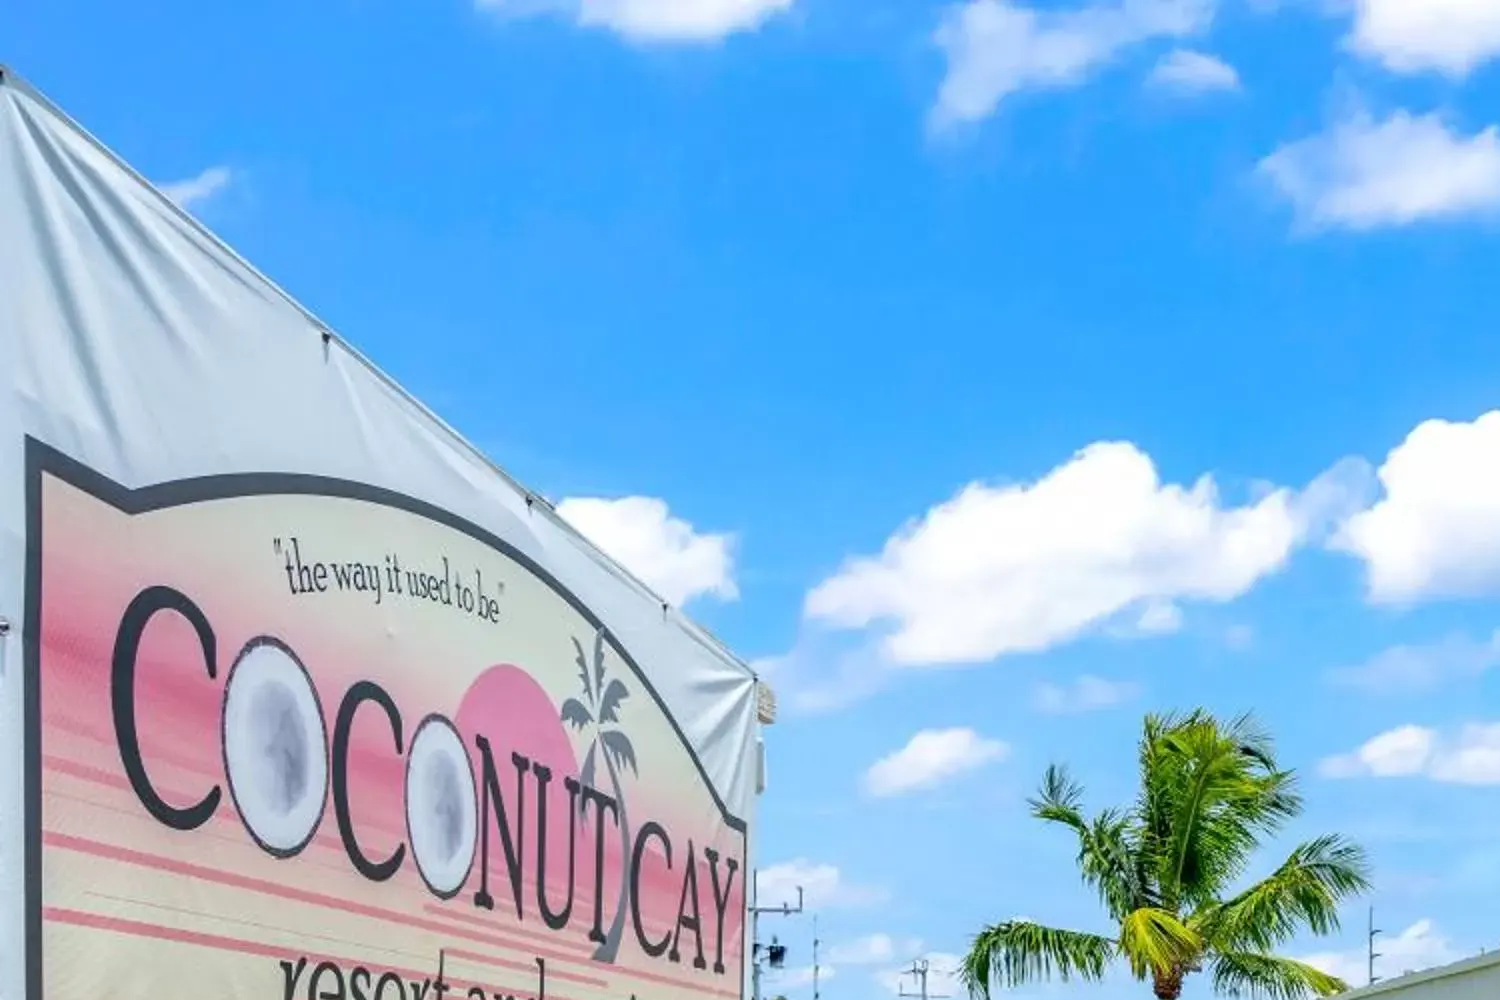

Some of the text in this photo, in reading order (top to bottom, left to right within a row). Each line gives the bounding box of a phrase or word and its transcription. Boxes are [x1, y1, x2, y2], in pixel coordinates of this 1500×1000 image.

[273, 537, 327, 595] "the
[331, 561, 381, 605] way
[385, 552, 402, 594] it
[405, 556, 452, 605] used
[454, 572, 474, 613] to
[110, 584, 738, 974] COCONUT CAY
